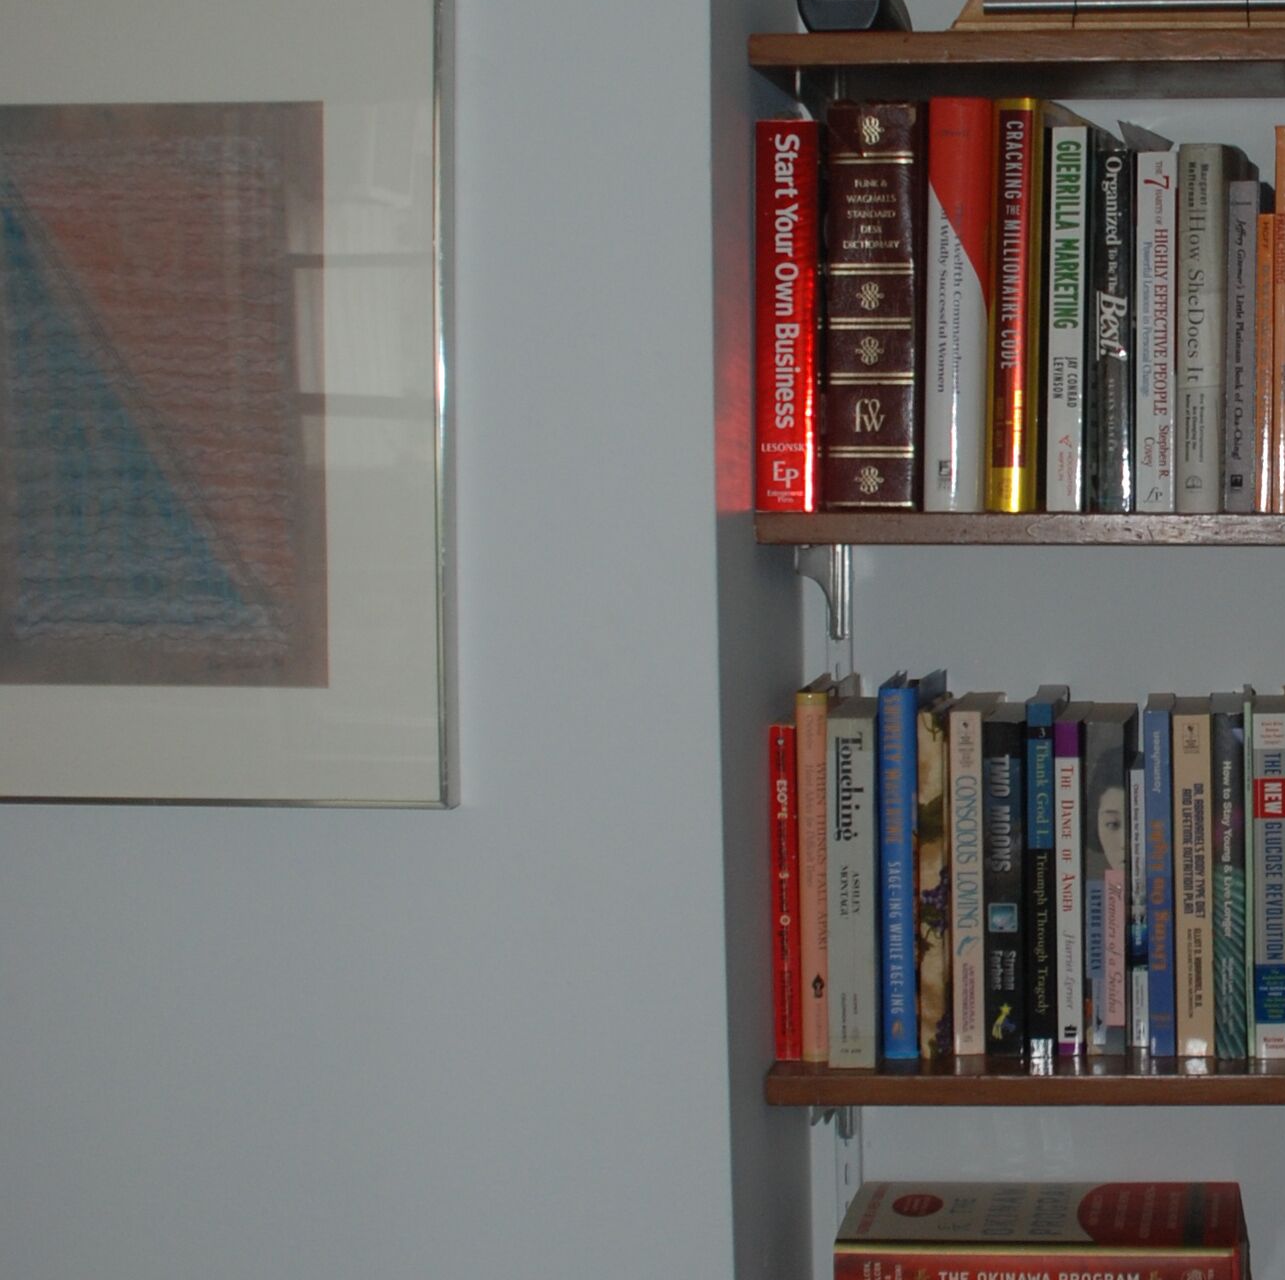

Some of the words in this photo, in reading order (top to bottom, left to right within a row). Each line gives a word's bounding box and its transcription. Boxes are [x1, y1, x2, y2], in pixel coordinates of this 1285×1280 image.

[774, 133, 800, 199] Start
[1004, 121, 1023, 199] CRACKING
[1143, 175, 1169, 189] 7
[1054, 141, 1080, 231] GUERRILLA
[1102, 156, 1122, 246] Organized
[774, 203, 800, 257] Your
[847, 209, 896, 219] STANDARD
[1006, 205, 1020, 215] THE
[842, 239, 900, 250] DICTIONARY
[1107, 248, 1117, 260] To
[1153, 228, 1168, 279] HIGHLY
[1187, 216, 1204, 260] How
[774, 262, 800, 316] Own
[1001, 220, 1021, 322] MILLIONAIRE
[1052, 239, 1078, 328] MARKETING
[1107, 261, 1117, 274] Be
[1107, 275, 1118, 295] The
[1187, 269, 1204, 306] She
[1098, 291, 1127, 361] Best!
[1153, 284, 1168, 358] EFFECTIVE
[1187, 308, 1204, 358] Does
[1001, 329, 1019, 369] CODE
[1066, 357, 1077, 372] JAY
[774, 323, 800, 429] Business
[1052, 357, 1063, 400] LEVINSON
[1066, 376, 1077, 408] CONRAD
[1153, 362, 1168, 415] PEOPLE
[1187, 367, 1204, 382] It
[1142, 437, 1156, 466] Covey
[1157, 425, 1169, 465] Stephen
[989, 755, 1011, 797] TWO
[1034, 741, 1049, 788] Thank
[1061, 766, 1074, 790] THE
[1265, 753, 1281, 775] THE
[834, 732, 863, 841] Touching
[1264, 781, 1282, 814] NEW
[955, 776, 977, 864] CONSCIOUS
[1034, 793, 1049, 826] God
[1061, 800, 1075, 840] DANCE
[989, 806, 1011, 872] MOONS
[1062, 849, 1074, 863] OF
[1265, 822, 1282, 878] GLUCOSE
[839, 865, 849, 919] MONTAGU
[852, 871, 860, 913] ASHLEY
[956, 871, 977, 929] LOVING
[1034, 853, 1049, 906] Triumph
[1061, 873, 1075, 913] ANGER
[1034, 910, 1049, 965] Through
[1265, 884, 1283, 961] REVOLUTION
[1034, 970, 1049, 1015] Tragedy
